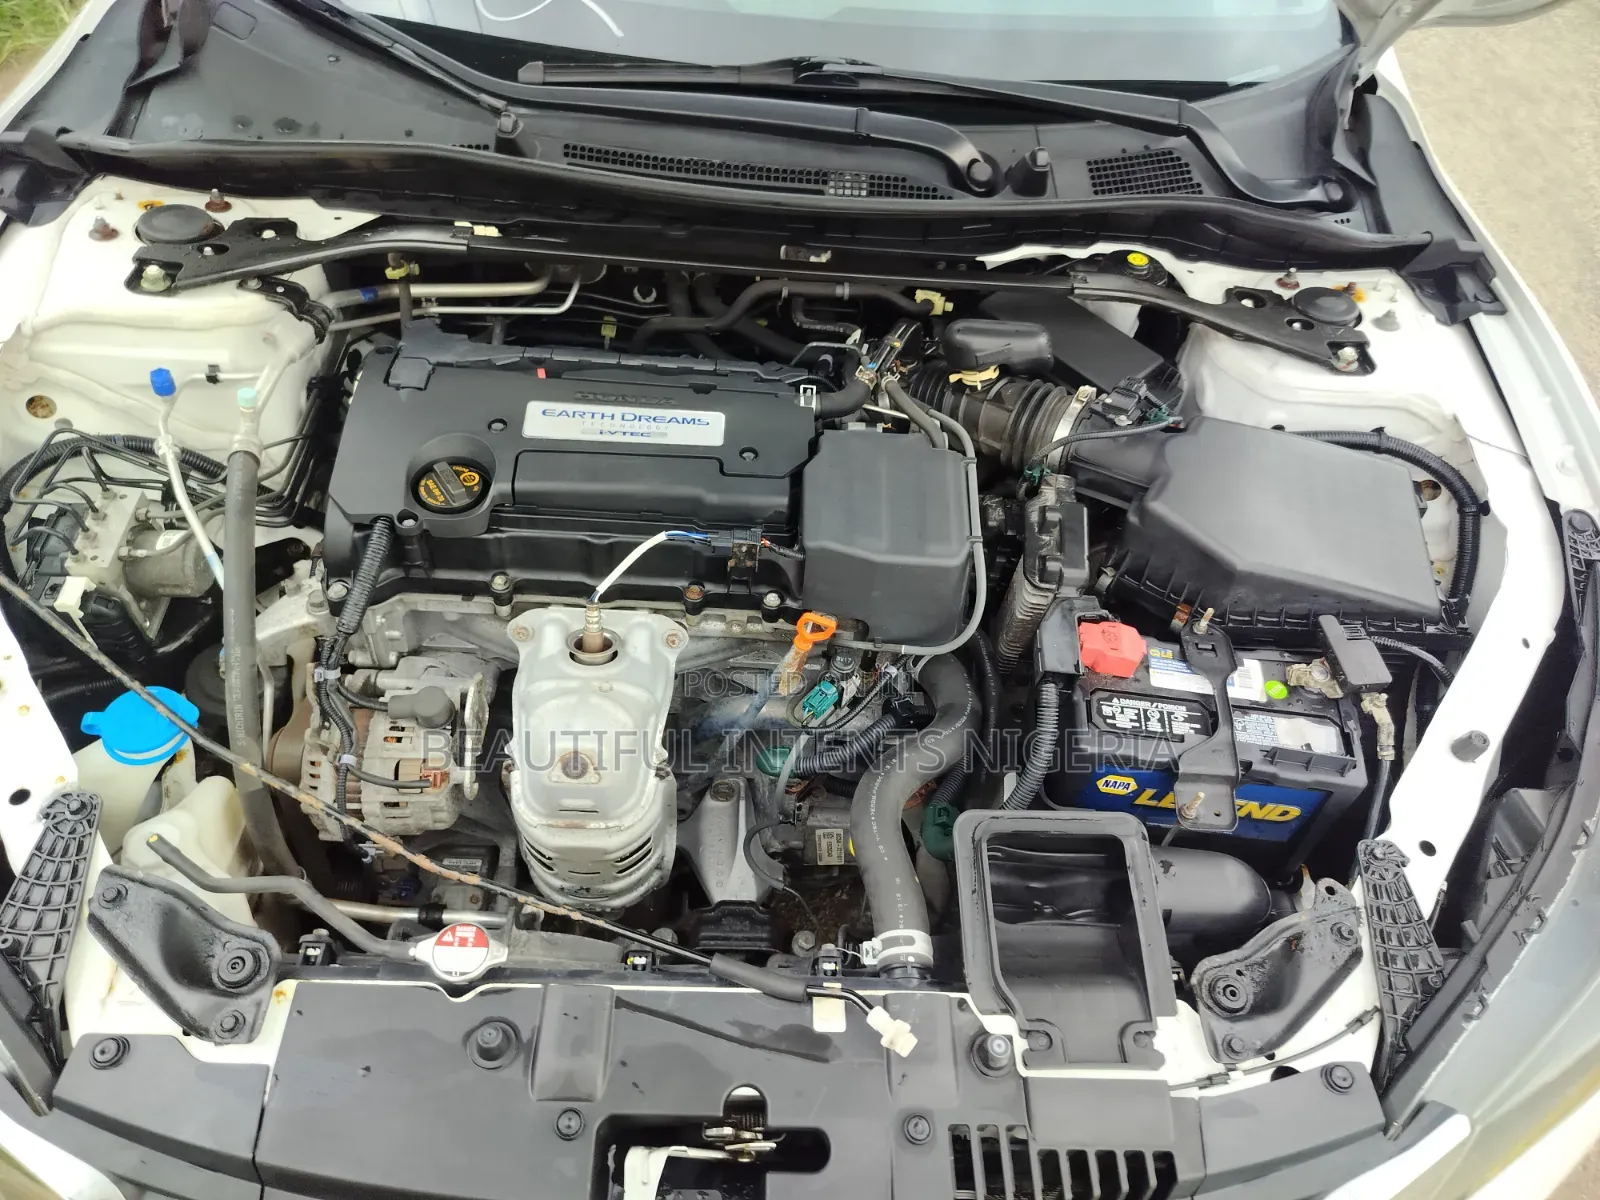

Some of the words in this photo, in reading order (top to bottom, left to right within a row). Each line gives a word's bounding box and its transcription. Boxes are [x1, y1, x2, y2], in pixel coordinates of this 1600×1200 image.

[541, 408, 615, 421] EARTH
[621, 412, 710, 426] DREAMS
[581, 421, 669, 430] TECHNOLOGY
[1101, 779, 1132, 792] NAPA
[1133, 787, 1302, 822] LEND
